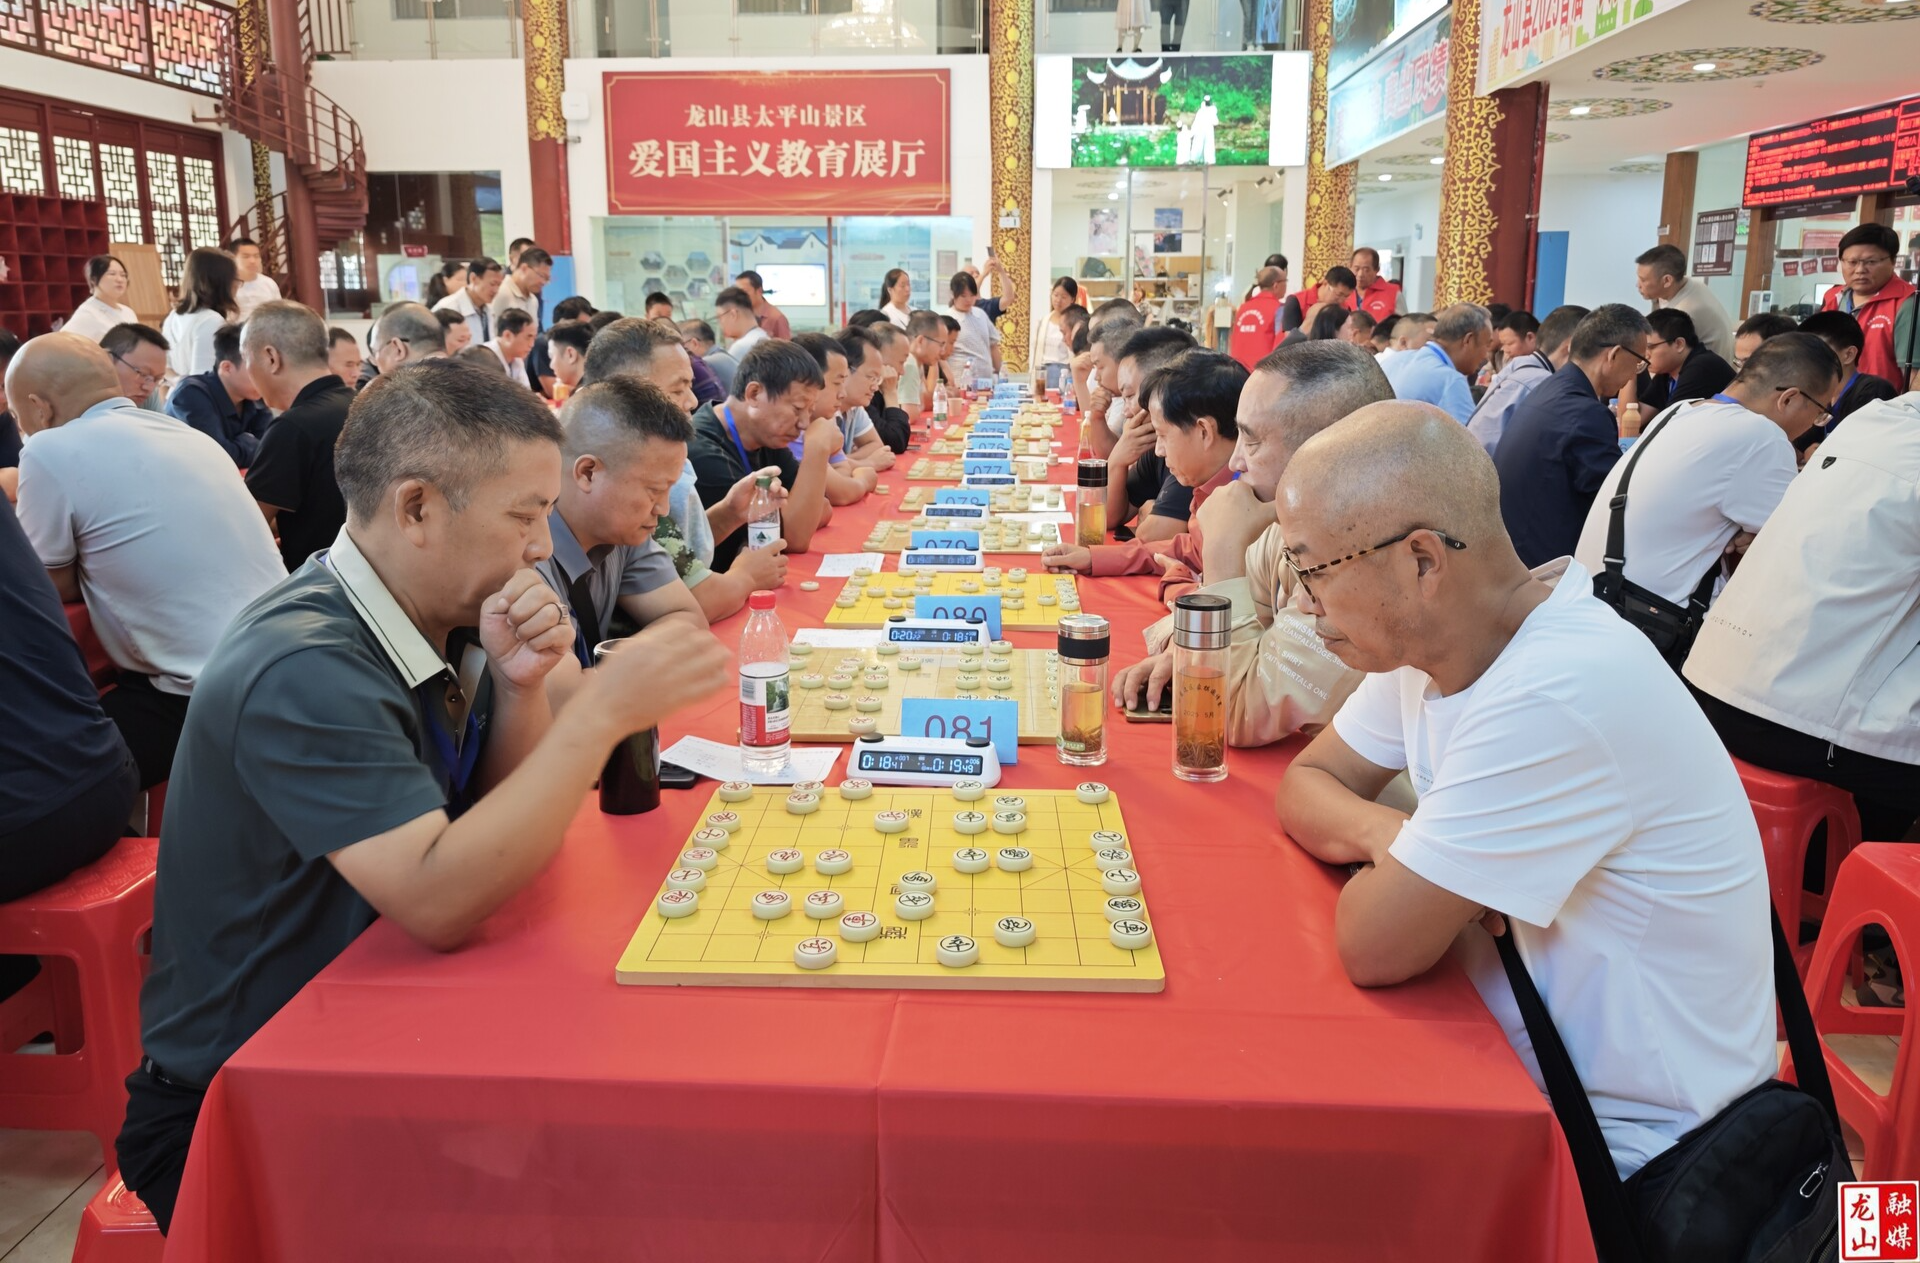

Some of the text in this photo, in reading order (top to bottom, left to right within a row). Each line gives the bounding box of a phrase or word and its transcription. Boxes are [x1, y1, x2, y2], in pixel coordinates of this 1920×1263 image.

[684, 104, 867, 128] 龙山县太平山景区
[628, 139, 926, 178] 爱国主义教育展厅
[1281, 649, 1305, 668] SHIRT
[925, 714, 993, 742] 081
